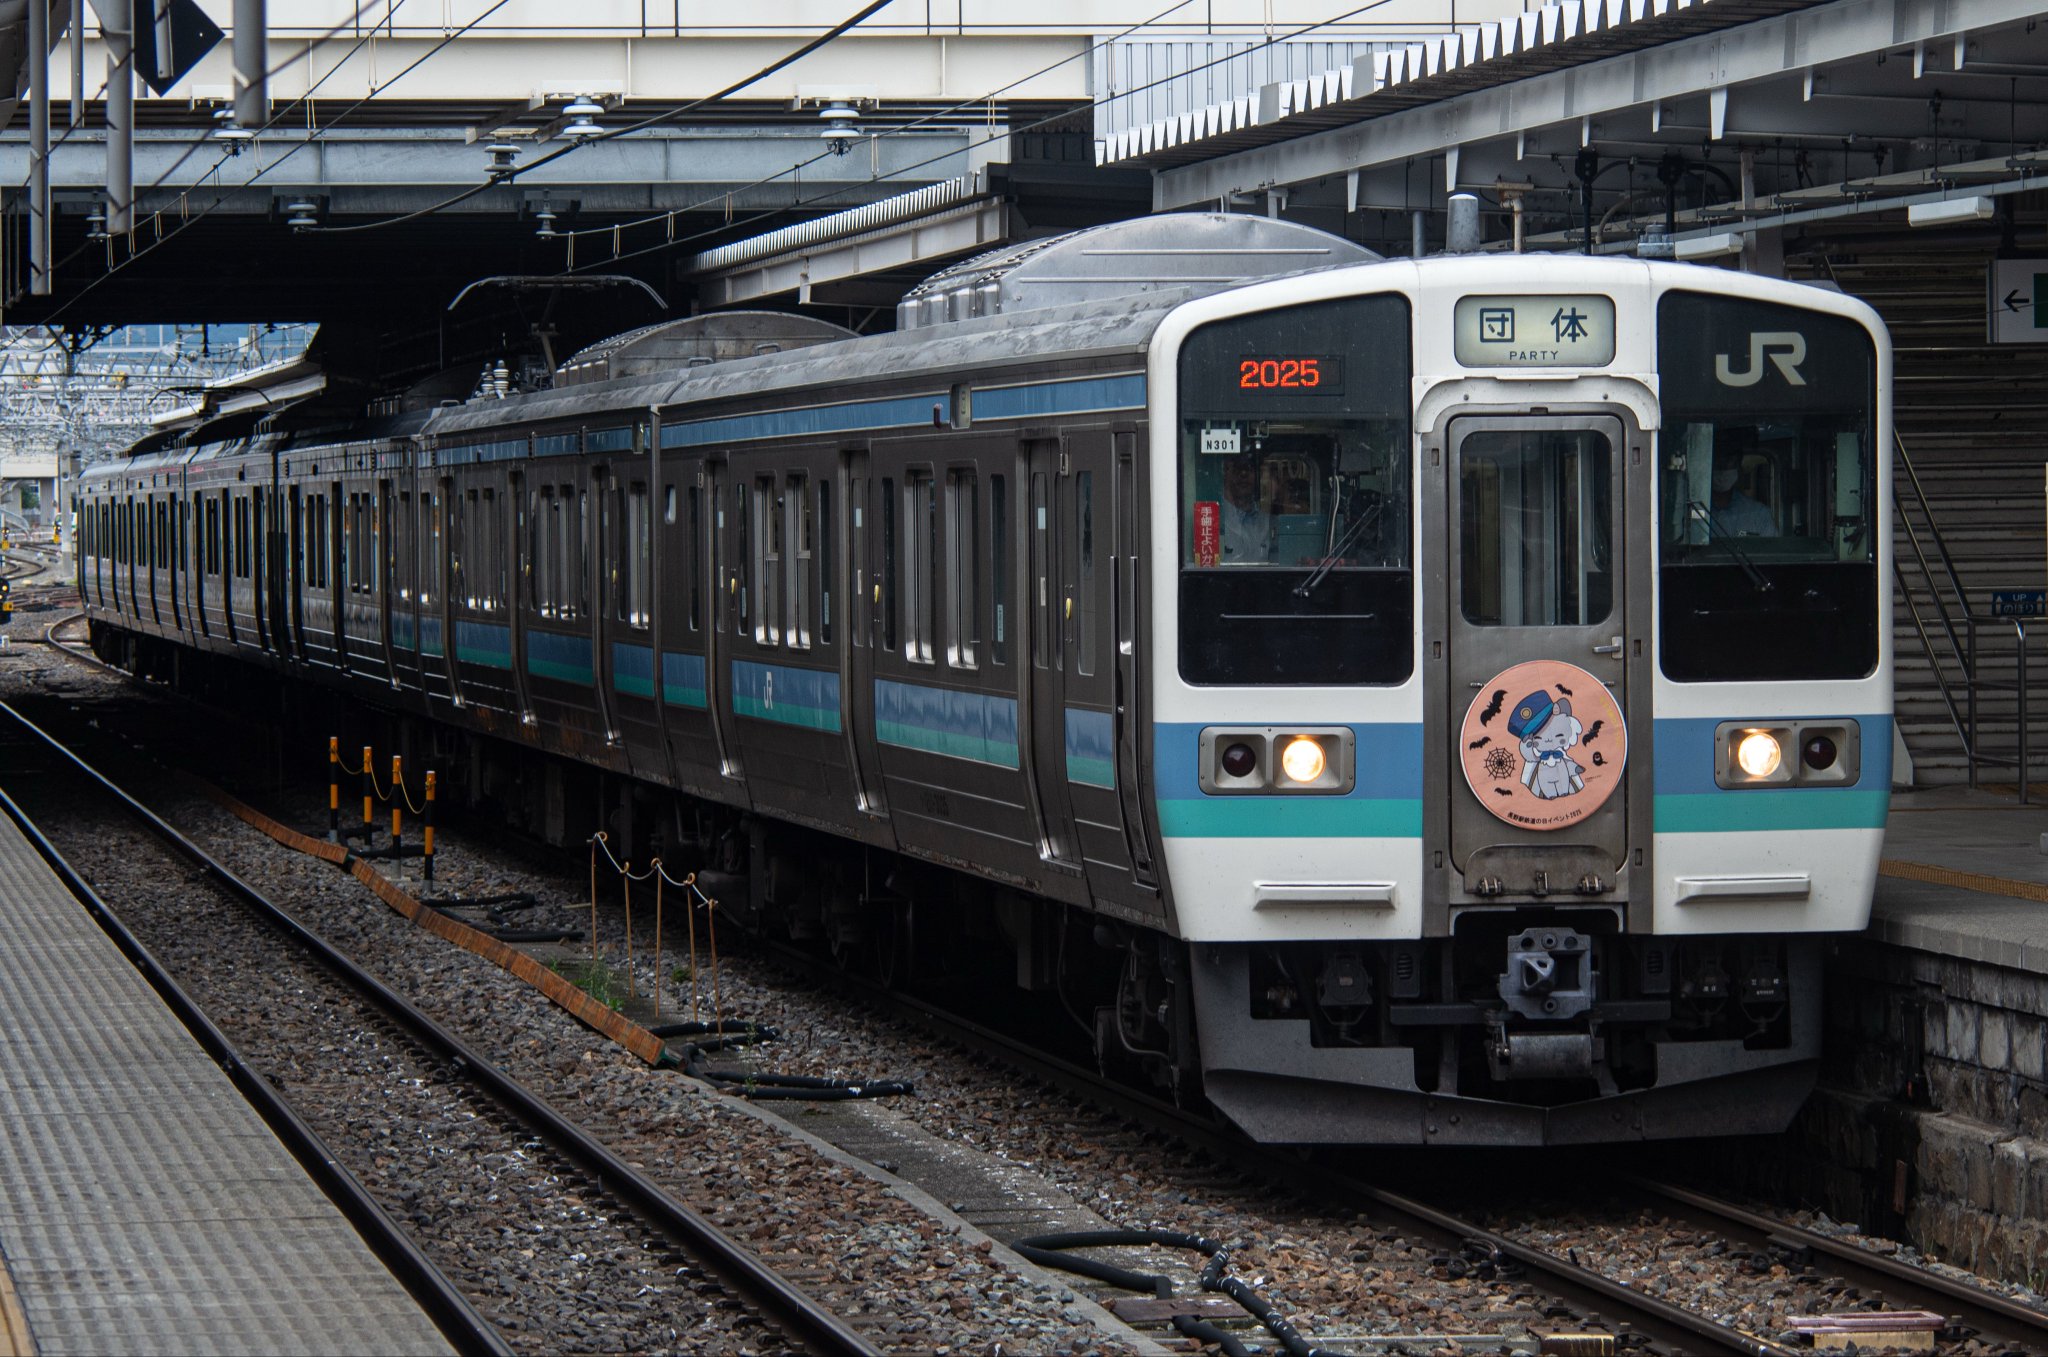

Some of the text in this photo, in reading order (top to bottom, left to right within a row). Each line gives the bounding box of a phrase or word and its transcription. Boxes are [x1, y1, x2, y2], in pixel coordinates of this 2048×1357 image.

[1480, 307, 1588, 343] 団体
[1509, 350, 1559, 360] PARTY
[1716, 332, 1807, 387] JR
[1240, 360, 1319, 387] 2025
[1206, 440, 1234, 450] N301
[2012, 593, 2027, 602] UP
[763, 671, 773, 710] JR
